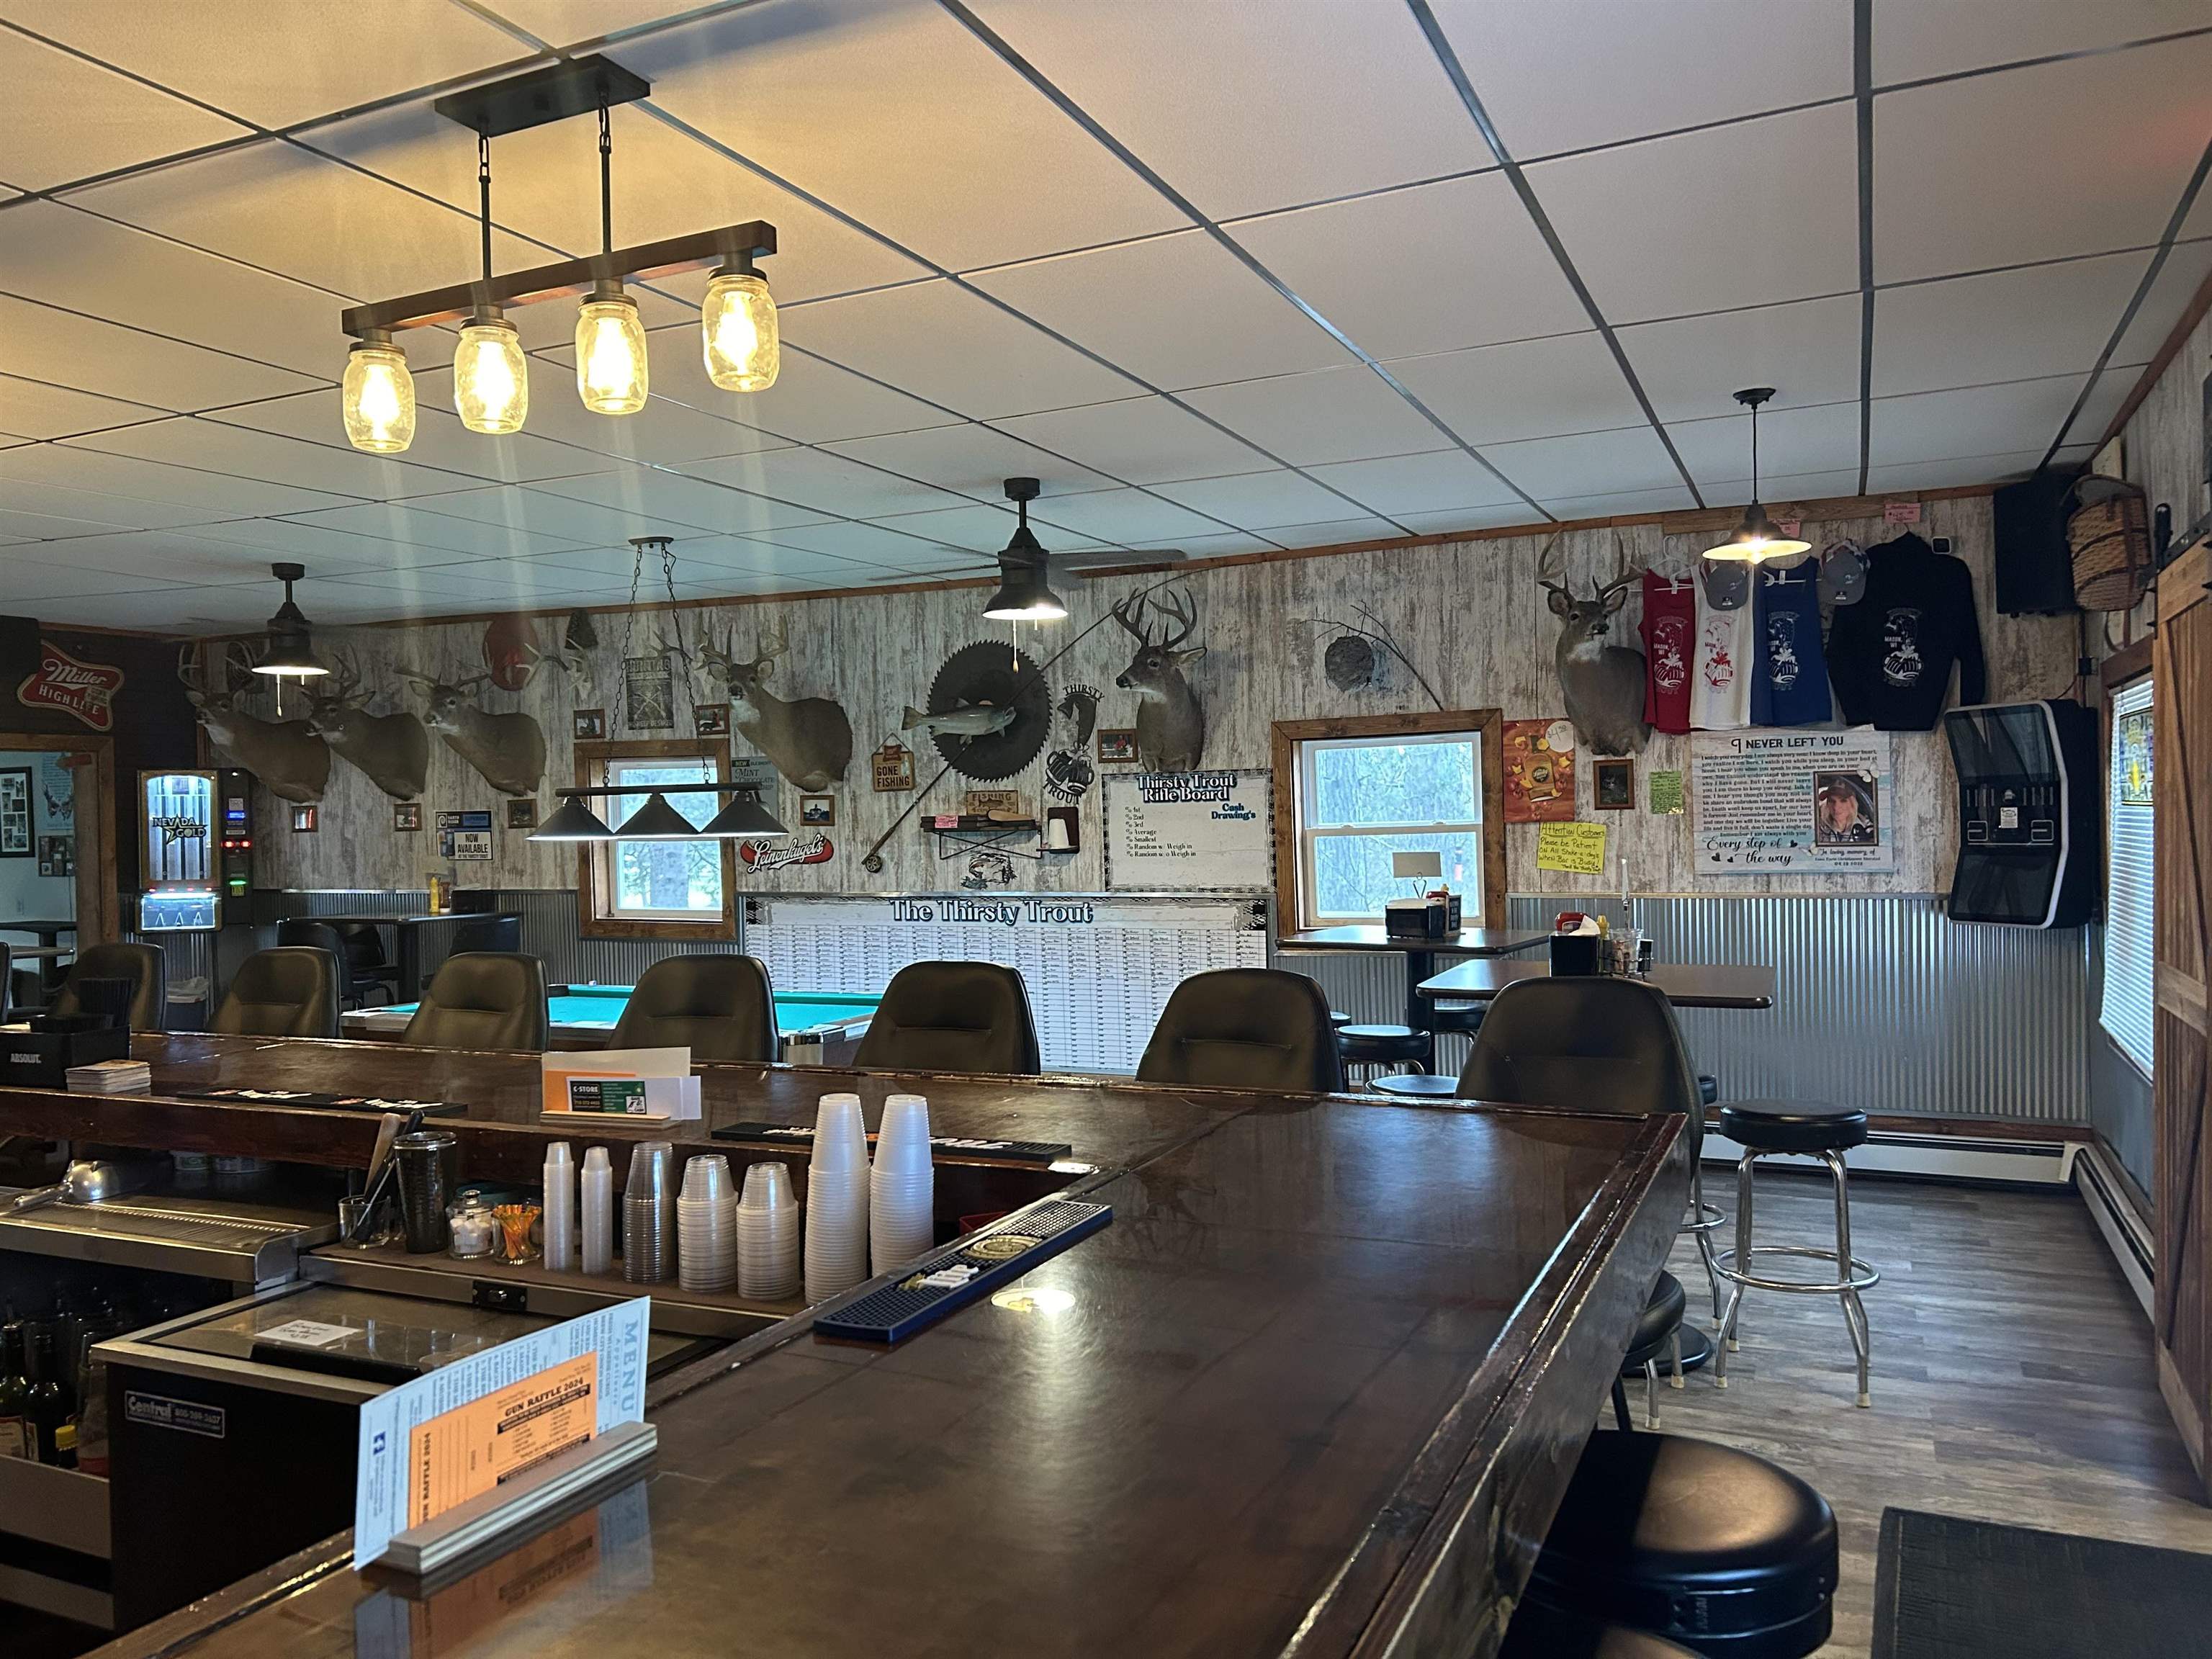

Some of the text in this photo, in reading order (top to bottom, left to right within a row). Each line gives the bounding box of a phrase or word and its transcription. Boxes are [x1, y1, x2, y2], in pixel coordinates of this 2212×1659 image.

[42, 658, 108, 684] Miller
[39, 685, 69, 703] HIGH
[1063, 684, 1105, 703] THIRSTY
[1731, 736, 1843, 753] I NEVER LEFT YOU
[735, 768, 760, 778] MINT
[877, 766, 899, 776] GONE
[877, 776, 910, 788] FISHING
[1136, 773, 1236, 788] Thirsty Trout
[1143, 786, 1230, 802] Rifle Board
[1211, 811, 1256, 820] Drawing's
[1222, 804, 1244, 812] Cash
[153, 816, 196, 827] NEVADA
[176, 828, 207, 838] GOLD
[465, 834, 479, 842] NOW
[458, 844, 488, 853] AVAILABLE
[1541, 837, 1558, 846] Please
[1571, 838, 1598, 850] Patient
[1702, 836, 1782, 851] Every step of
[747, 832, 825, 873] Leinenkugel's
[1735, 850, 1793, 866] the way
[890, 899, 1093, 926] The Thirsty Trout
[10, 1053, 42, 1064] ABSOLUT.
[621, 1319, 639, 1412] MENU
[505, 1401, 524, 1417] GUN
[527, 1386, 563, 1407] RAFFLE
[564, 1377, 583, 1393] 2024
[128, 1395, 171, 1418] Central
[423, 1433, 432, 1459] 2024
